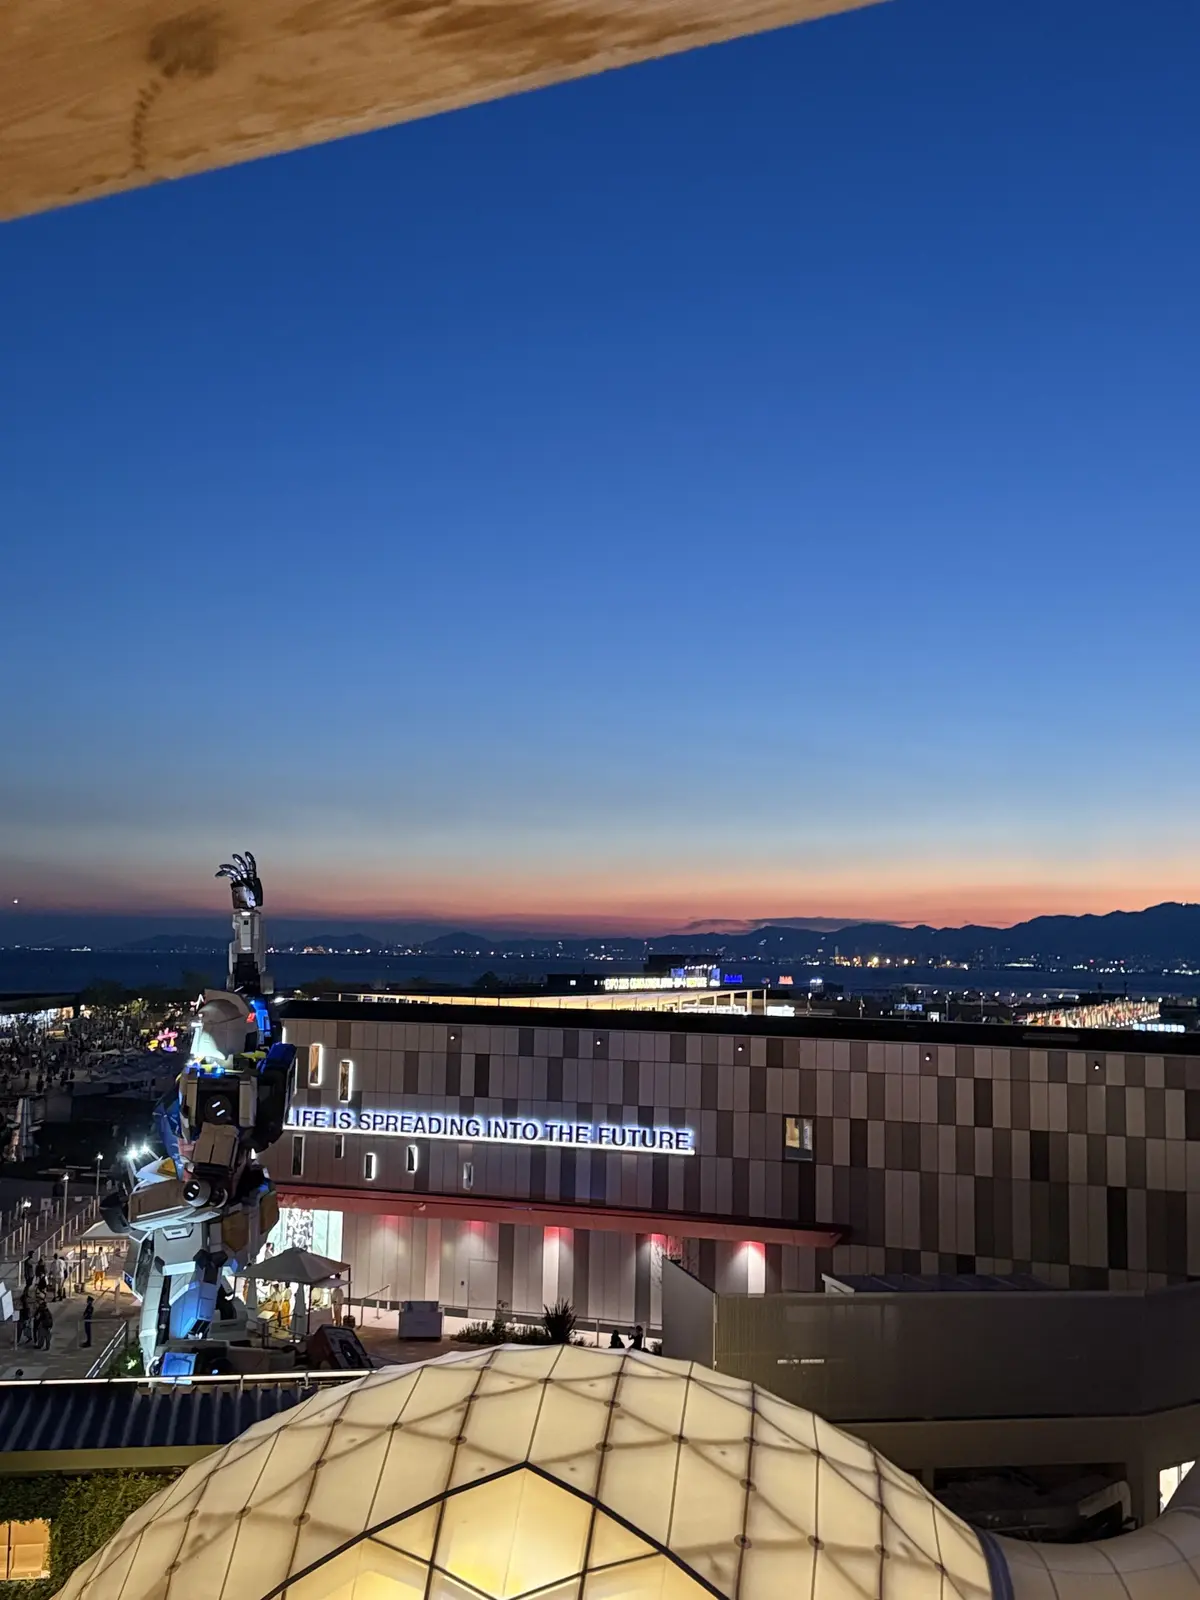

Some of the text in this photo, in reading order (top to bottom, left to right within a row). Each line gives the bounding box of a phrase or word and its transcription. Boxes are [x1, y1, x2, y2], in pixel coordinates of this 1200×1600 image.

[285, 1109, 690, 1150] LIFE IS SPREADING INTO THE FUTURE
